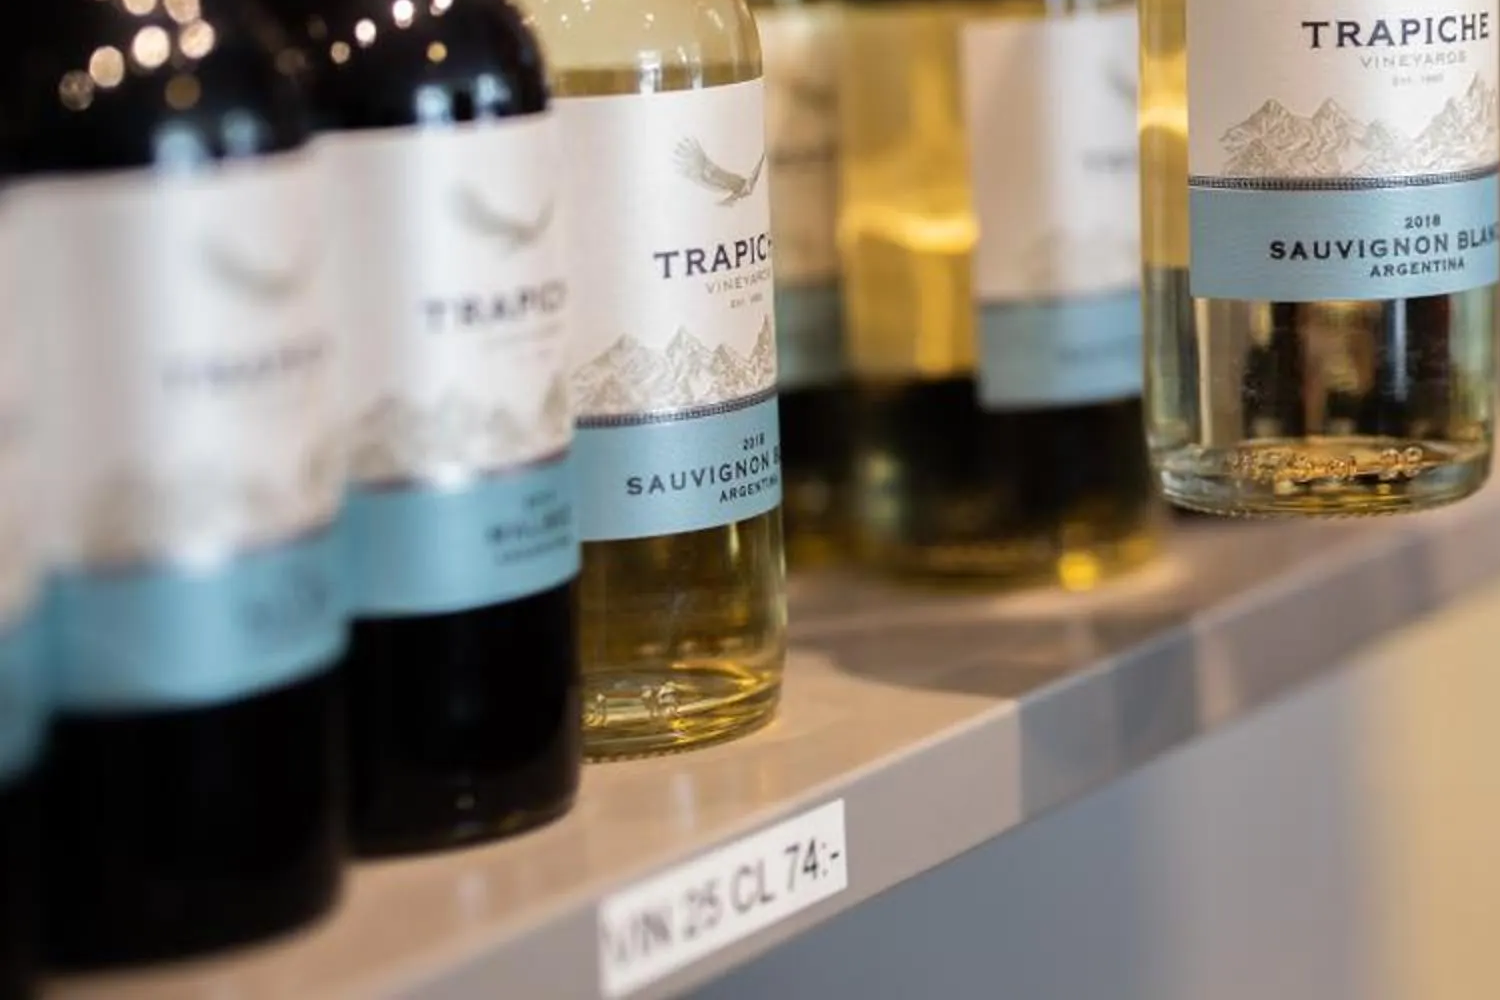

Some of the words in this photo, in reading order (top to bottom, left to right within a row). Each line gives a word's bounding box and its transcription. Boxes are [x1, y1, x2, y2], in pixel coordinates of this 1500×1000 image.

[1301, 12, 1490, 49] TRAPICHE
[1360, 50, 1468, 69] VINEYARDS
[1404, 213, 1442, 230] 2018
[1269, 233, 1450, 261] SAUVIGNON
[1369, 256, 1466, 279] ARGENTINA
[742, 431, 766, 451] 2018
[626, 450, 770, 496] SAUVIGNON
[729, 859, 776, 915] CL
